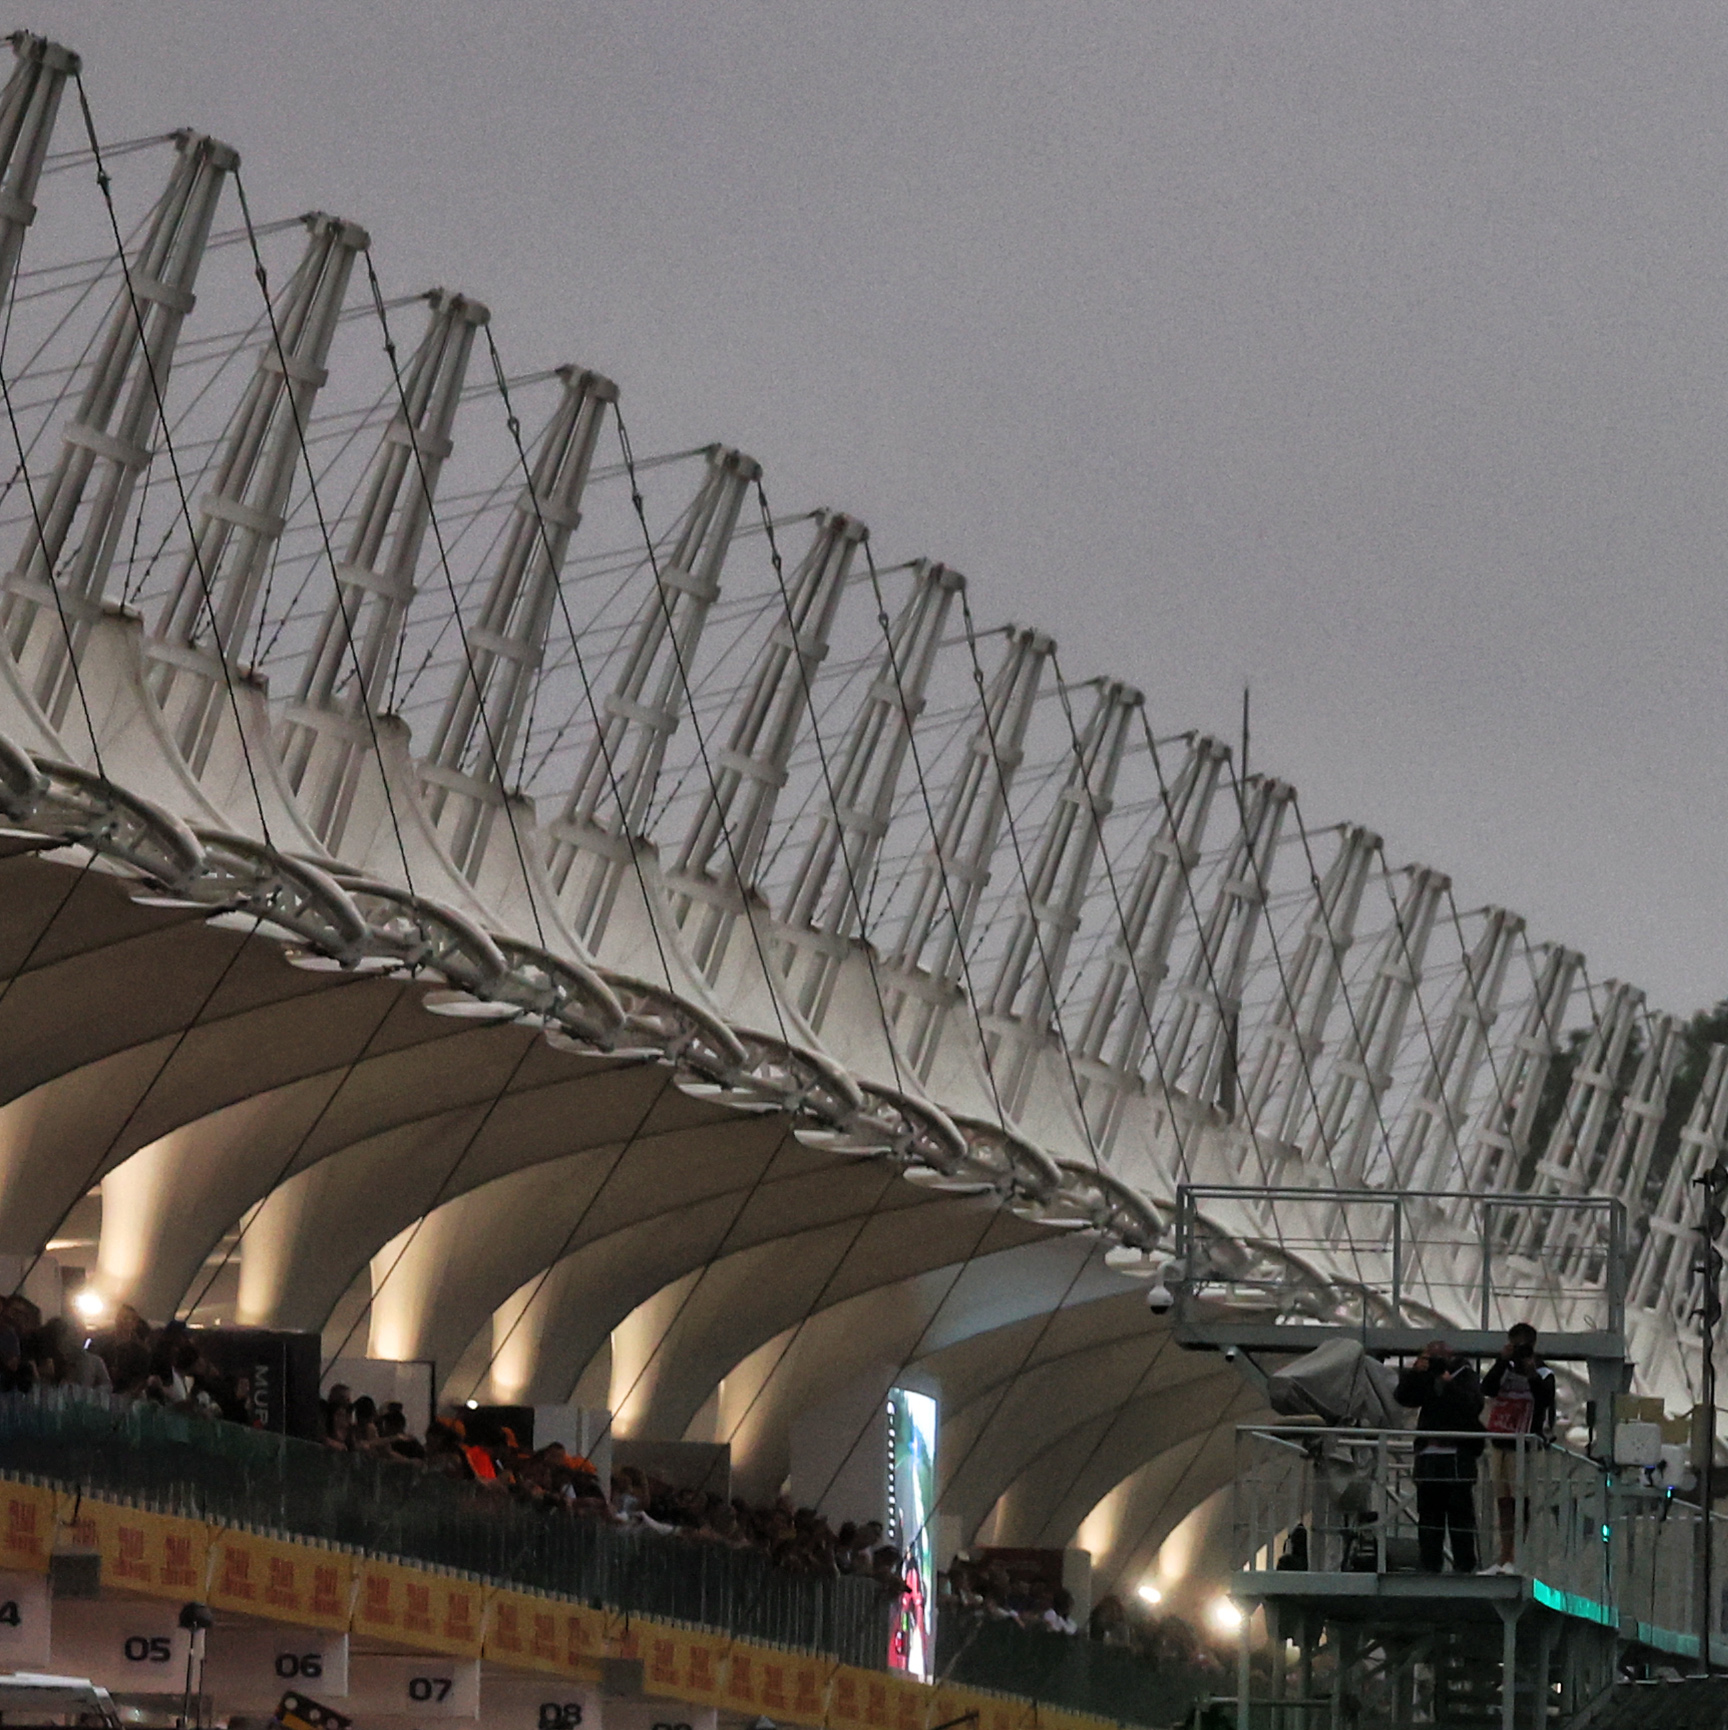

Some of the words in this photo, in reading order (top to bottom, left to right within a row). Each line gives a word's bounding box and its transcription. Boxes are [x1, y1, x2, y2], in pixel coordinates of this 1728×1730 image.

[124, 1636, 171, 1662] 05
[274, 1653, 323, 1679] 06
[408, 1677, 452, 1702] 07
[538, 1702, 583, 1730] 08
